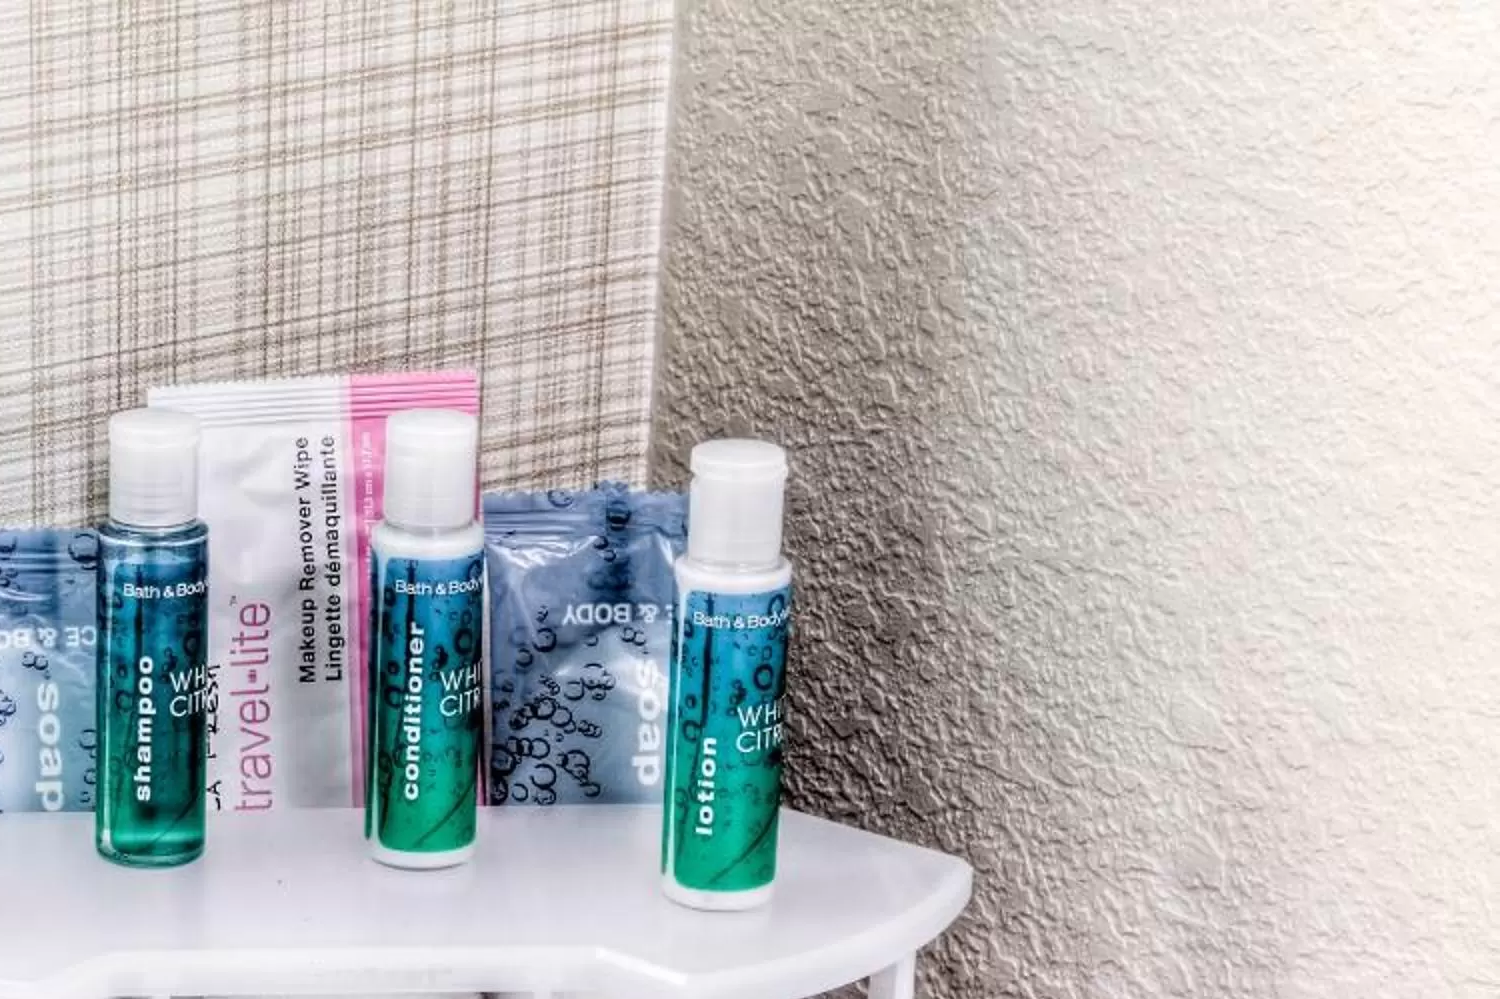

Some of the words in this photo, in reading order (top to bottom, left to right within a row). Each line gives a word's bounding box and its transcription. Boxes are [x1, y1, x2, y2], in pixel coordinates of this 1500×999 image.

[294, 437, 311, 490] Wipe
[298, 497, 316, 591] Remover
[321, 435, 341, 587] démaquillante
[124, 583, 160, 598] Bath
[163, 585, 174, 598] &
[395, 580, 431, 595] Bath
[435, 583, 446, 595] &
[563, 603, 632, 625] BODY
[694, 611, 730, 629] Bath
[733, 616, 745, 629] &
[37, 628, 57, 648] &
[298, 600, 316, 684] Makeup
[325, 594, 346, 682] Lingette
[35, 683, 64, 811] soap
[134, 656, 156, 802] shampoo
[404, 622, 425, 801] conditioner
[632, 658, 660, 785] soap
[695, 738, 718, 836] lotion
